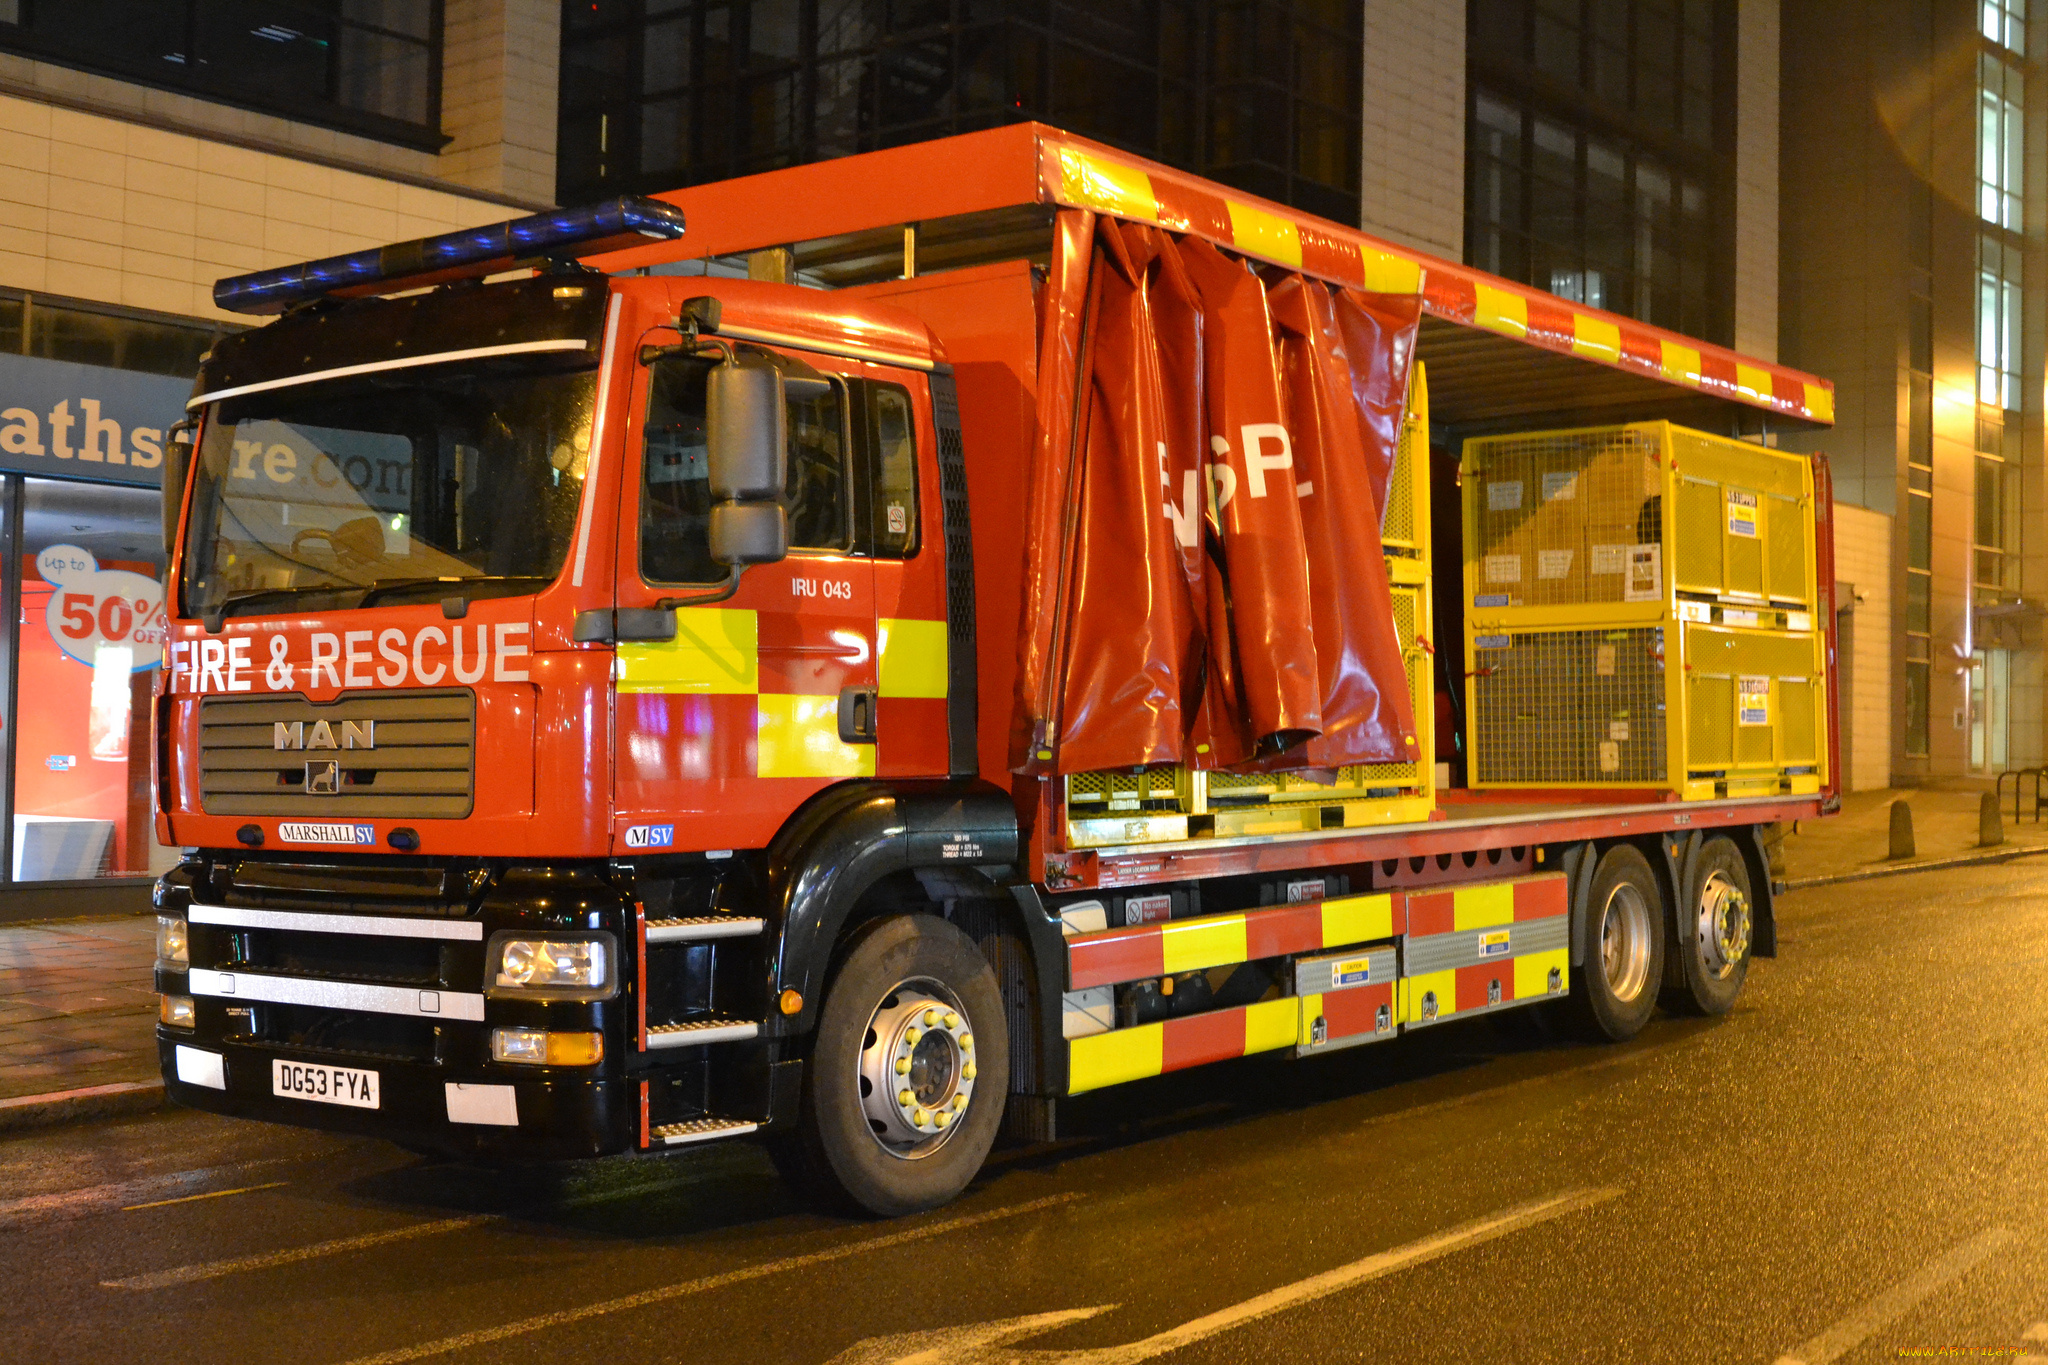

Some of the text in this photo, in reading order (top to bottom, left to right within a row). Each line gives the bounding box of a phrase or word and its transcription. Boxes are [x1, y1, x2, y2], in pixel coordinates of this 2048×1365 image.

[70, 557, 85, 571] to
[792, 577, 851, 599] IRU 043
[60, 593, 165, 641] 50%
[170, 622, 529, 694] FIRE & RESCUE
[274, 719, 374, 750] MAN
[1152, 901, 1167, 909] naked
[281, 1064, 371, 1101] DG53 FYA
